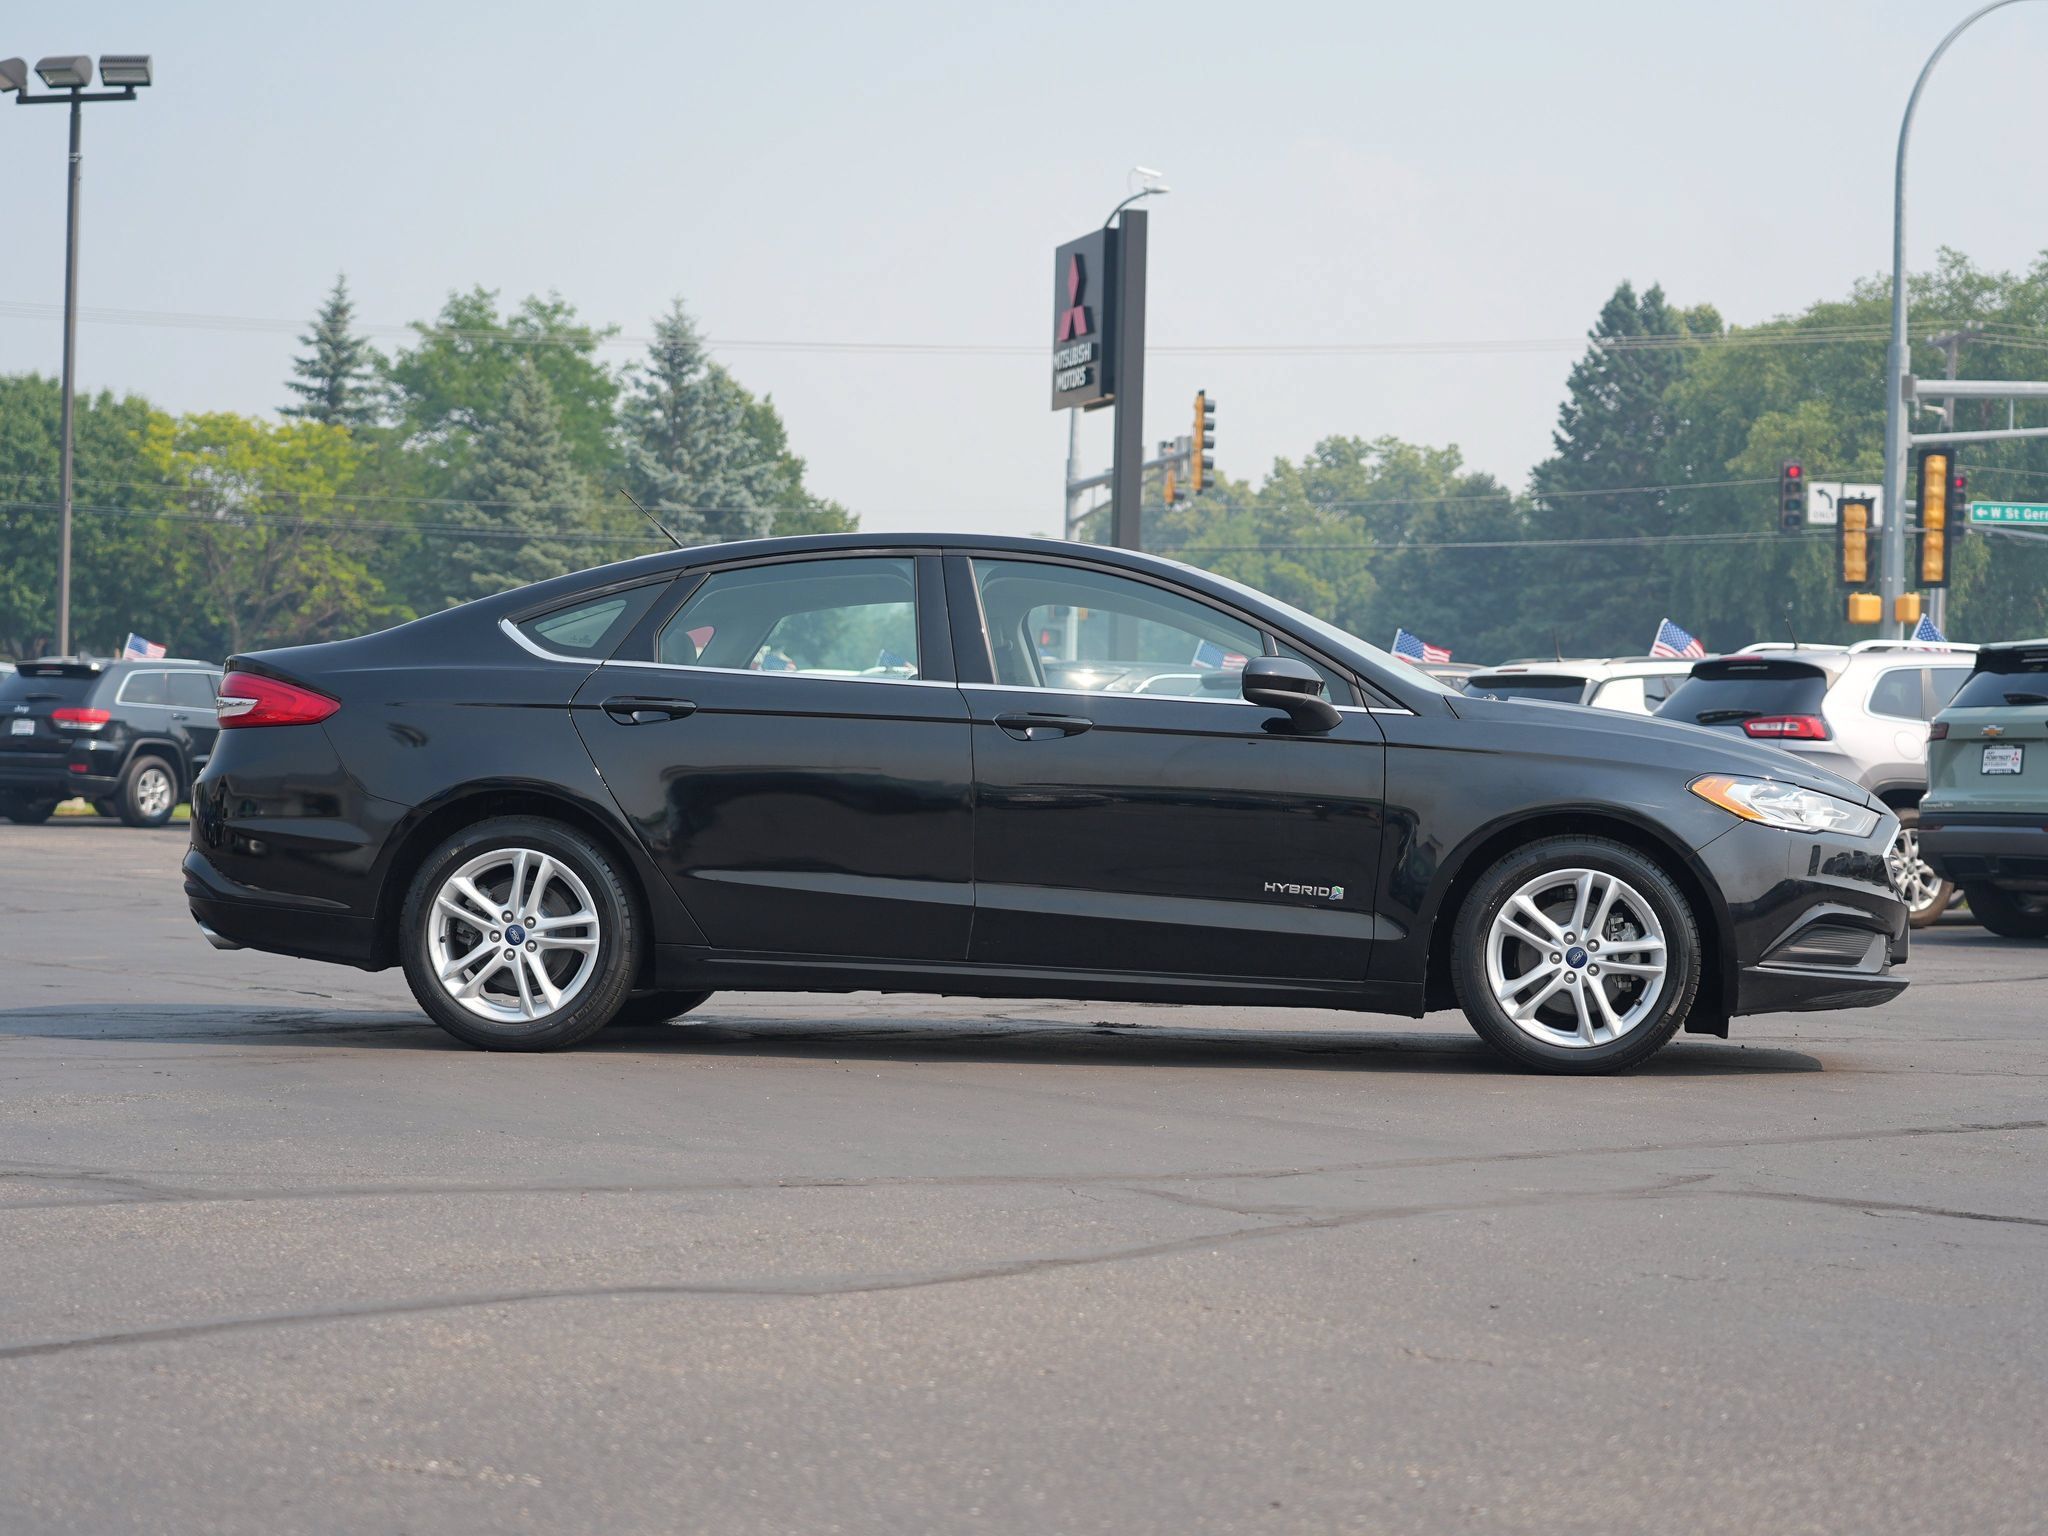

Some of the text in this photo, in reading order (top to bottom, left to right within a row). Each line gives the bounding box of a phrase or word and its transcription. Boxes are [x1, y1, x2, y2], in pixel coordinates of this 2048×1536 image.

[1056, 366, 1087, 392] MOTORS
[1990, 507, 2001, 519] W
[2005, 507, 2020, 520] St
[1263, 881, 1330, 897] HYBRID
